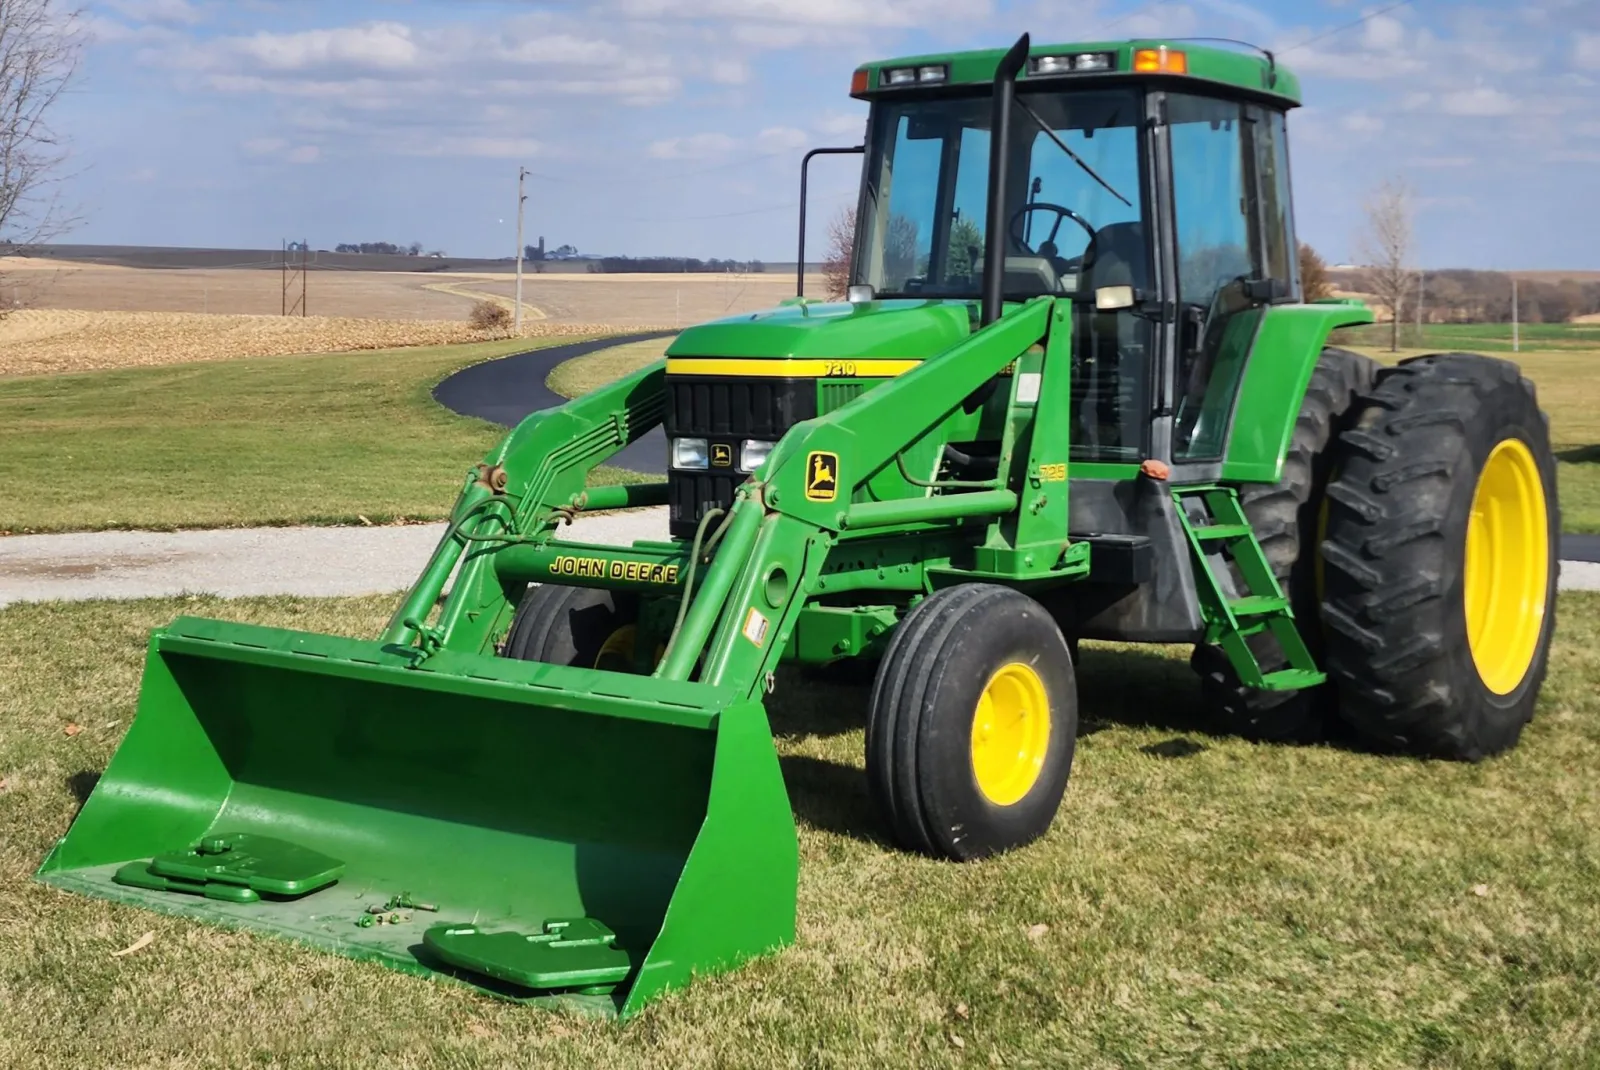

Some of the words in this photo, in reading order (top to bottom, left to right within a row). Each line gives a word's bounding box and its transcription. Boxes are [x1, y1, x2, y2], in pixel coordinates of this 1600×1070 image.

[824, 361, 857, 377] 7210
[1039, 464, 1066, 481] 725
[549, 556, 606, 577] JOHN
[610, 560, 679, 584] DEERE
